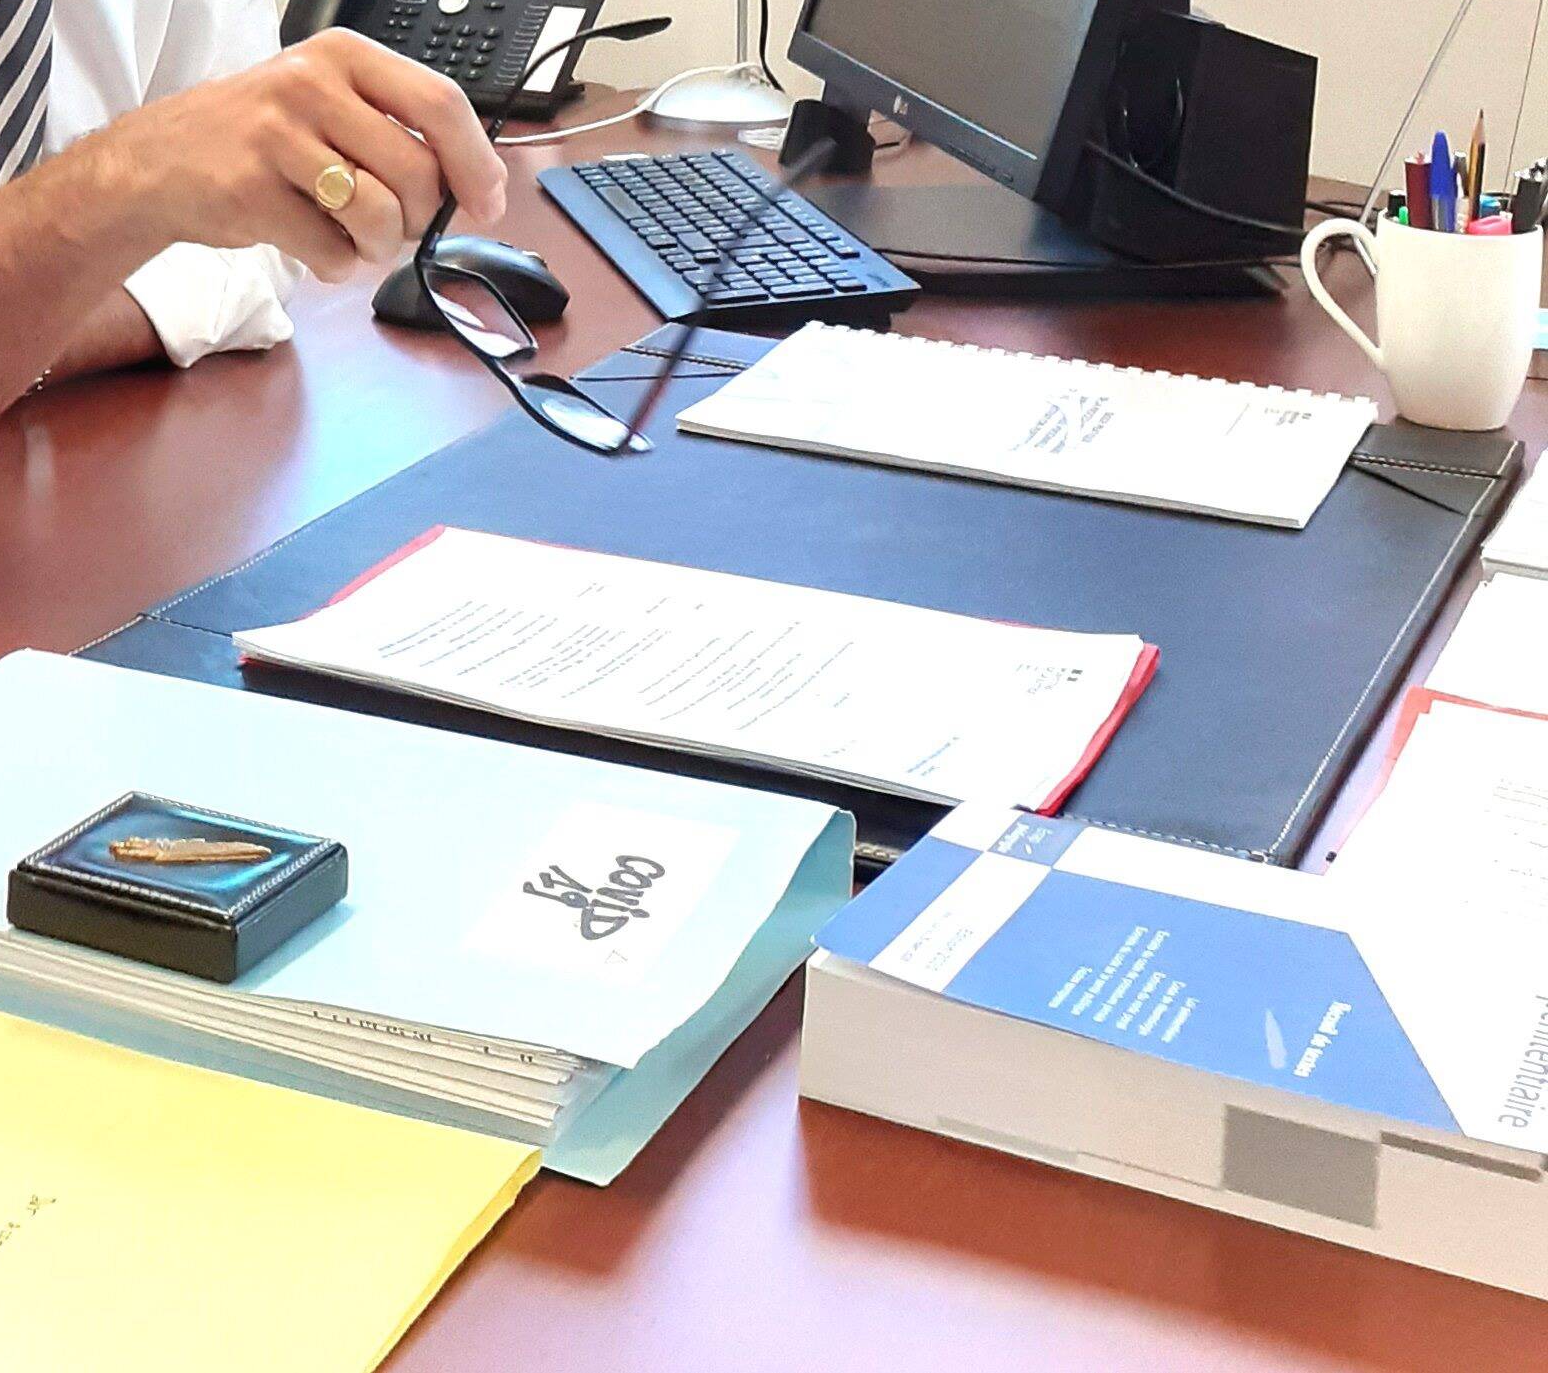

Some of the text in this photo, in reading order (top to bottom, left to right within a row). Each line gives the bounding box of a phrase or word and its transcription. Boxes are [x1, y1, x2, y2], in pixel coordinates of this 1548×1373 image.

[579, 855, 665, 940] COVID
[1311, 1034, 1331, 1047] de
[1319, 1002, 1351, 1034] Recueil
[1498, 994, 1548, 1128] tentiaire
